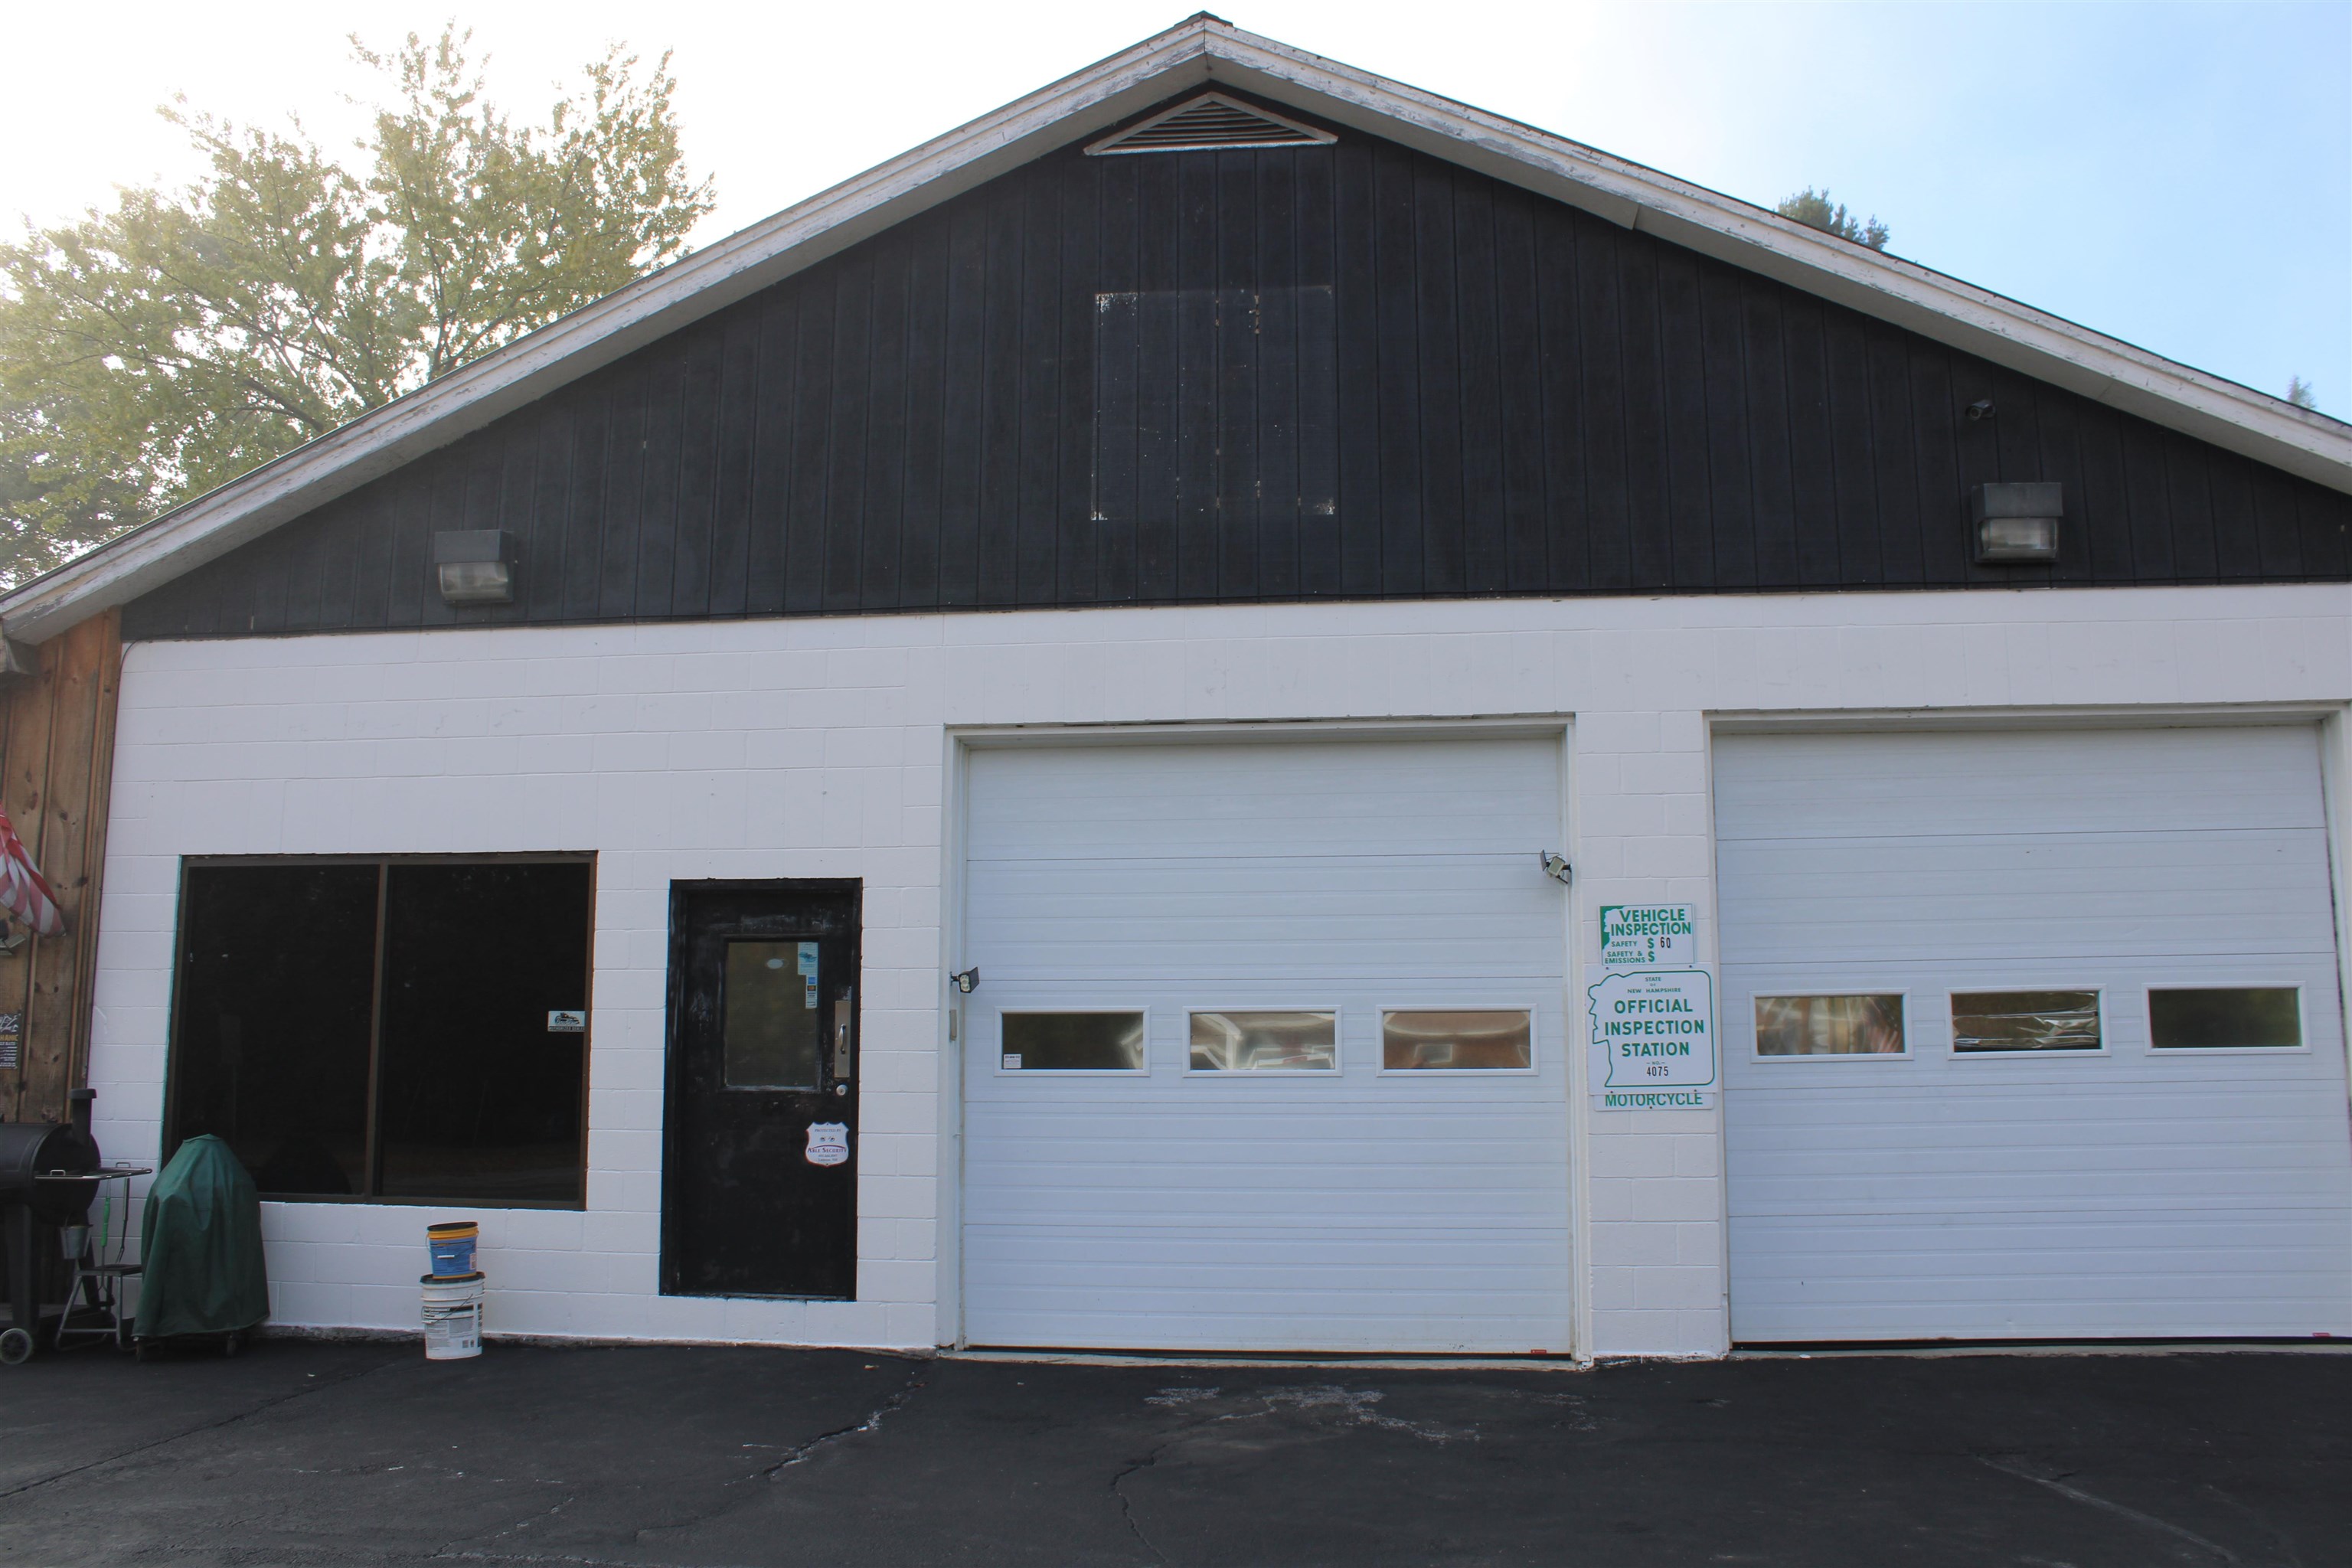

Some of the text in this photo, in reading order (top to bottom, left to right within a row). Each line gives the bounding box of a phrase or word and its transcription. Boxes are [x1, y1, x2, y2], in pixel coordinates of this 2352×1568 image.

[1619, 909, 1685, 923] VEHICLE
[1611, 922, 1691, 936] INSPECTION
[1647, 938, 1655, 949] $
[1660, 936, 1671, 949] 60
[1648, 951, 1655, 962] $
[1614, 998, 1693, 1014] OFFICIAL
[1605, 1019, 1704, 1036] INSPECTION
[1622, 1041, 1690, 1057] STATION
[1646, 1066, 1669, 1076] 4075
[1605, 1093, 1703, 1107] MOTORCYCLE
